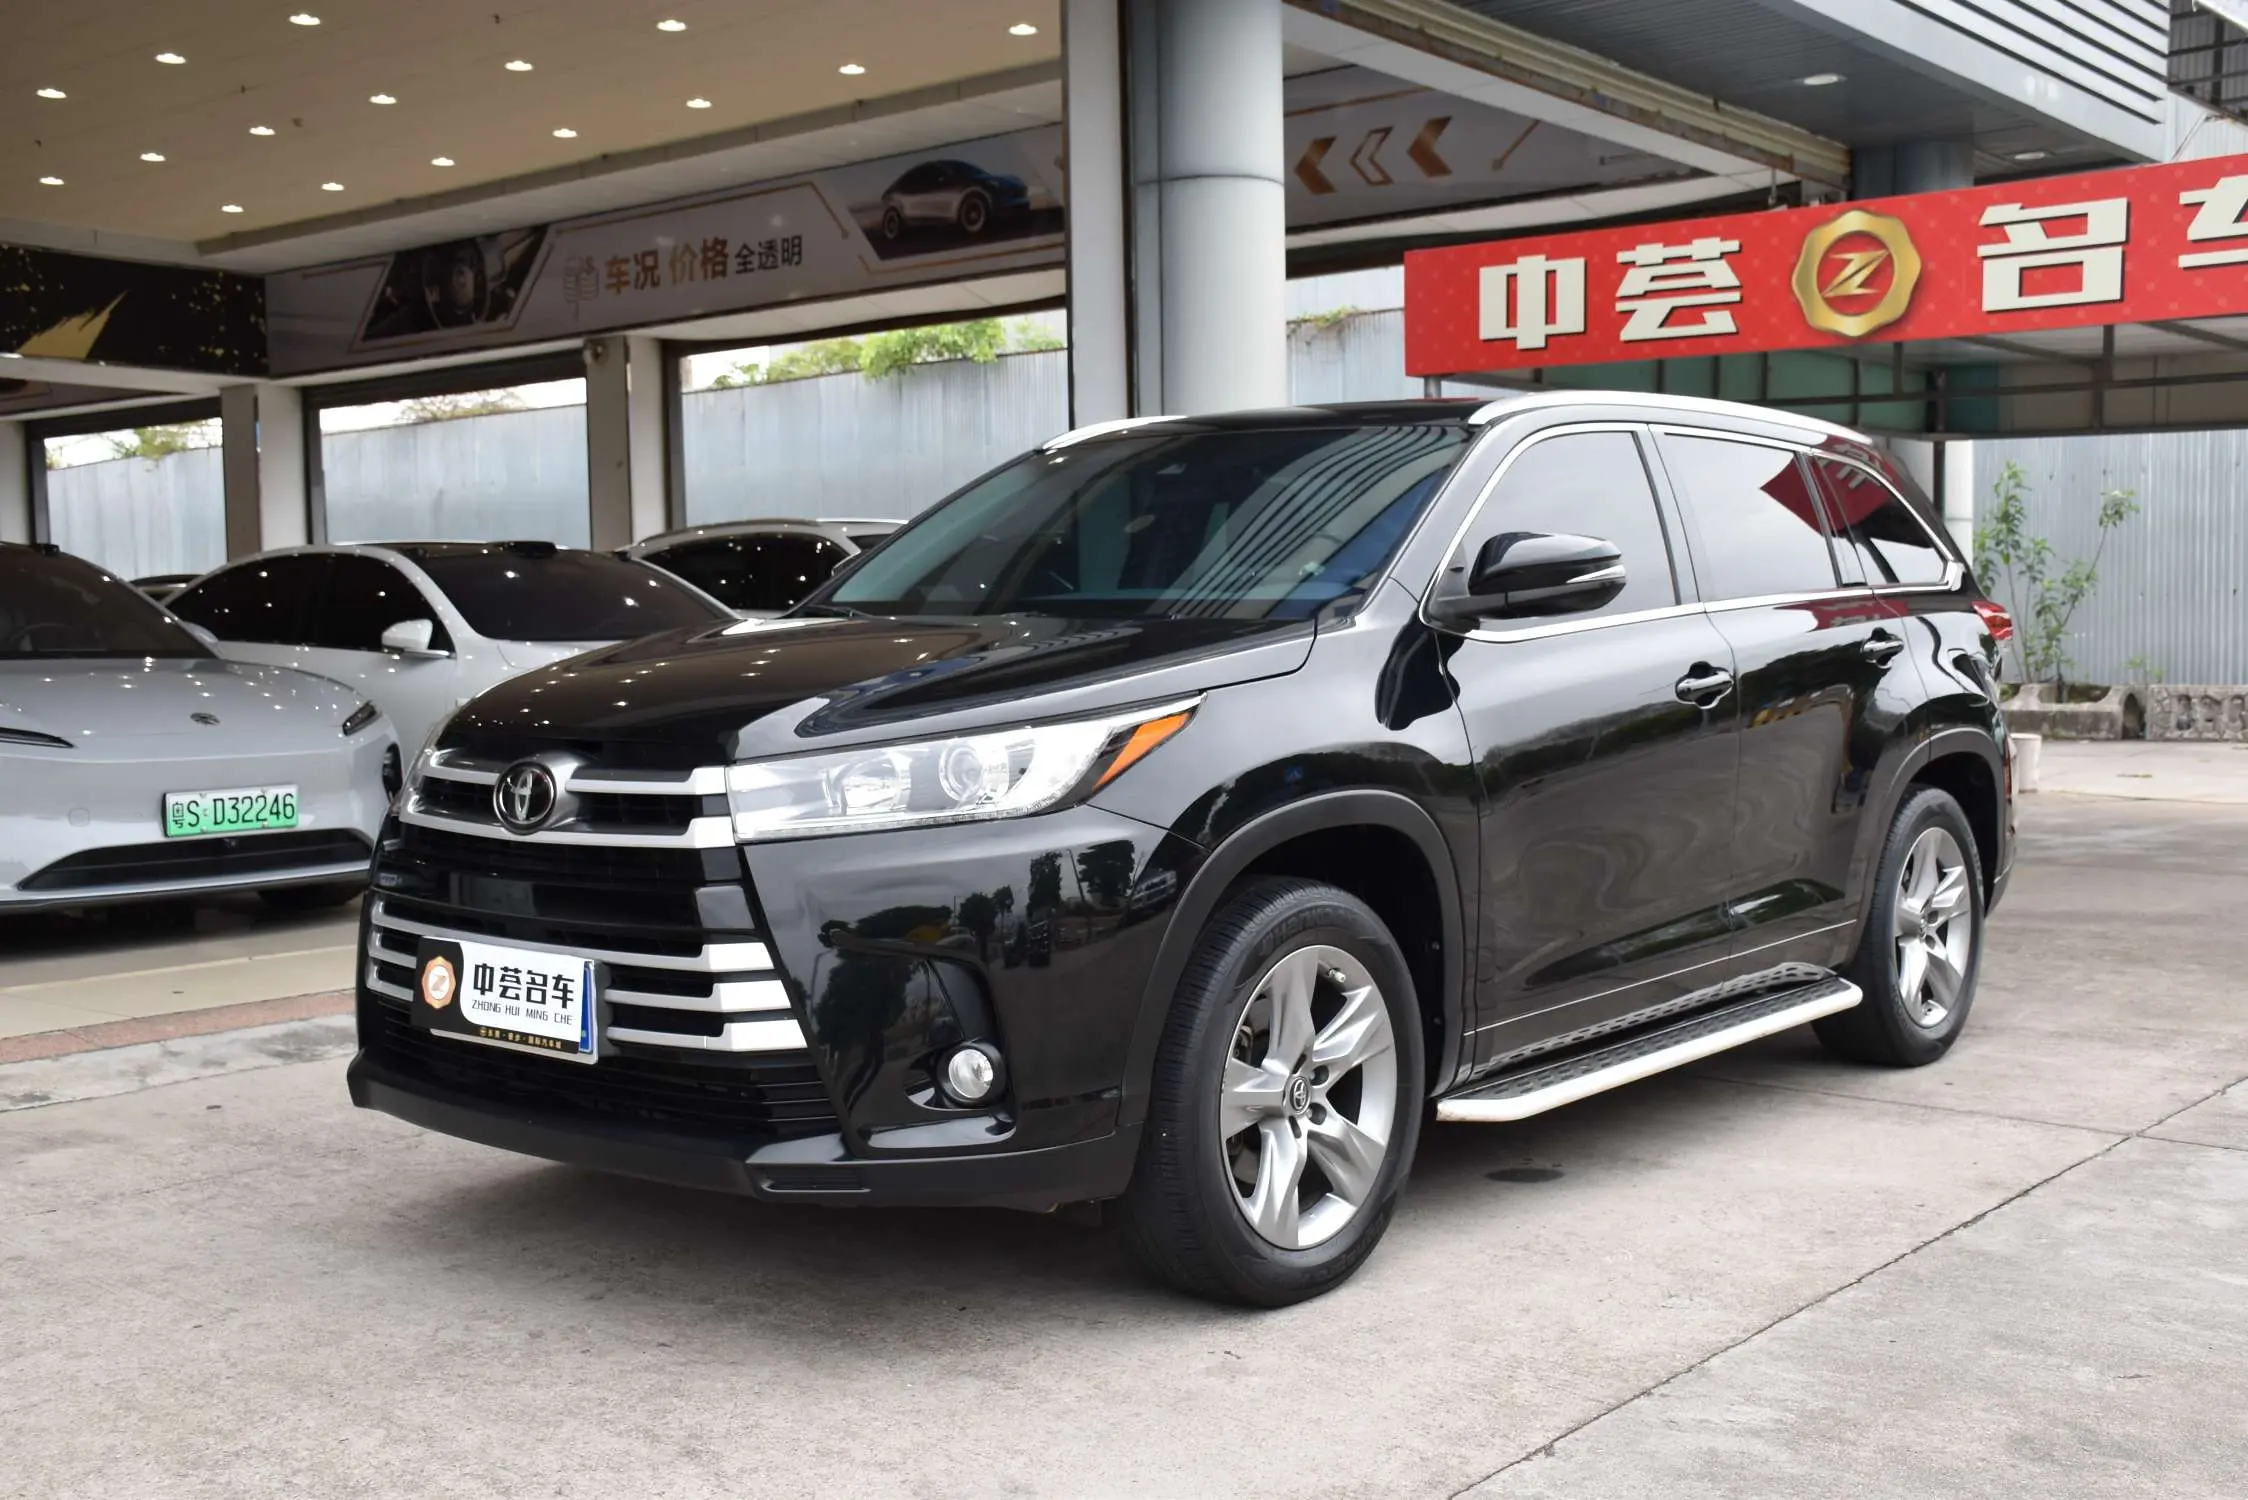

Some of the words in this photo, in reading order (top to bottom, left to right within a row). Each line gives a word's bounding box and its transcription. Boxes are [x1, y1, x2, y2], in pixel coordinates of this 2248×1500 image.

[605, 249, 661, 295] 车况
[668, 237, 729, 285] 价格
[734, 234, 803, 275] 全透明
[1479, 237, 1742, 350] 中荟
[471, 999, 502, 1014] ZHONG
[505, 1006, 520, 1017] HUI
[525, 1009, 549, 1022] MING
[554, 1012, 573, 1026] CHE
[473, 963, 575, 1009] 中荟名车
